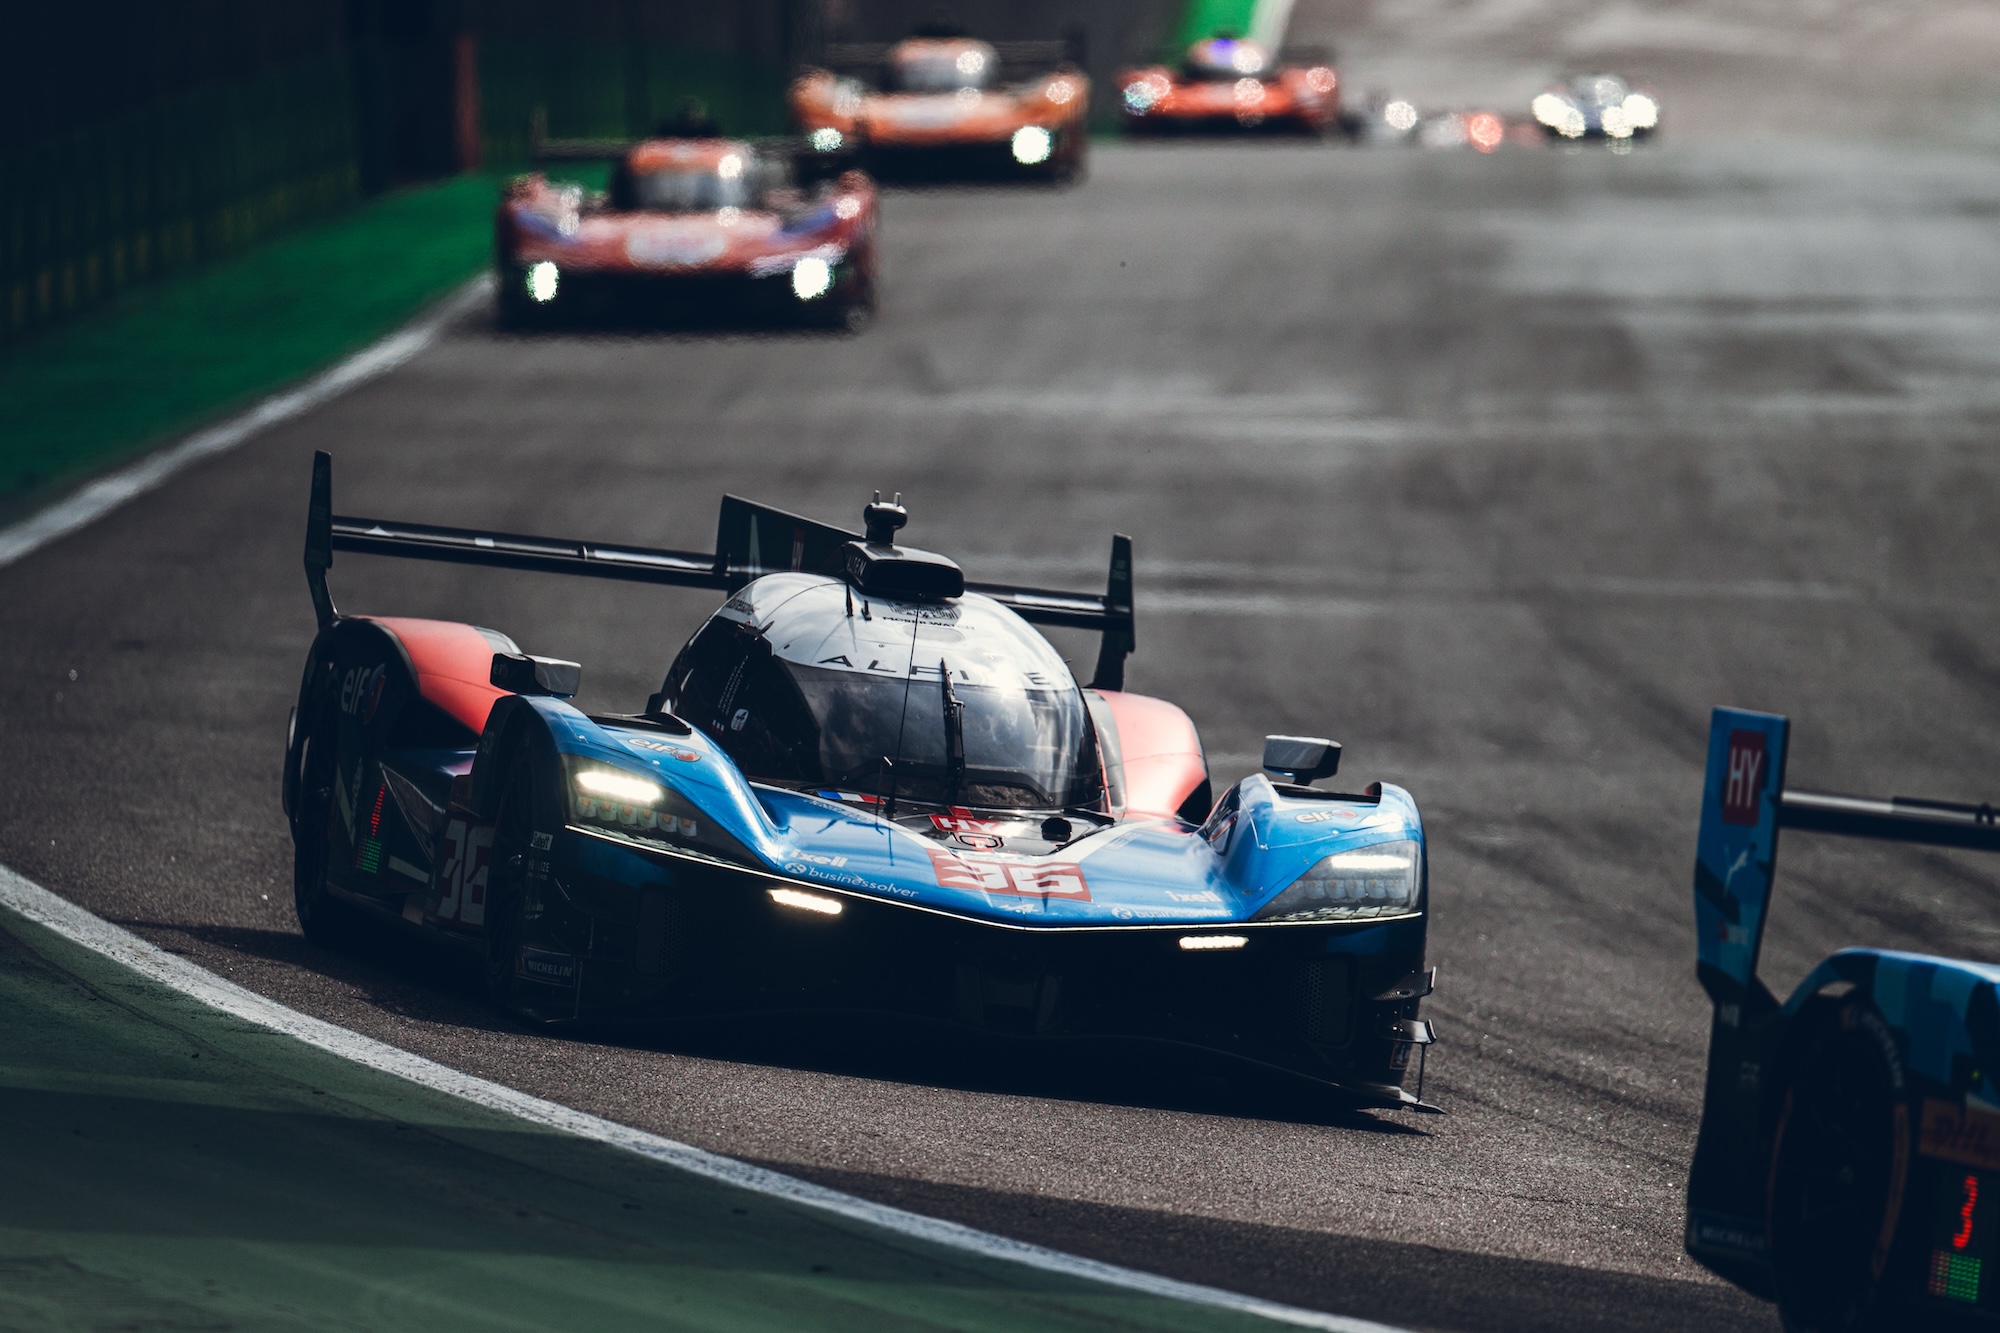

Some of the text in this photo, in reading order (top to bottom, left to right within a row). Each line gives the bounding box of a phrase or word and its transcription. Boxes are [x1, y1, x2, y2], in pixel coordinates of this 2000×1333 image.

[818, 654, 1051, 686] ALPIE
[341, 667, 371, 715] elf
[628, 738, 676, 754] elf
[1727, 747, 1762, 808] HY
[938, 817, 996, 832] HY
[1295, 811, 1332, 824] elf
[438, 818, 495, 926] 36
[808, 866, 919, 898] businessolver
[934, 855, 1083, 894] 36
[528, 960, 573, 977] MICHELIN
